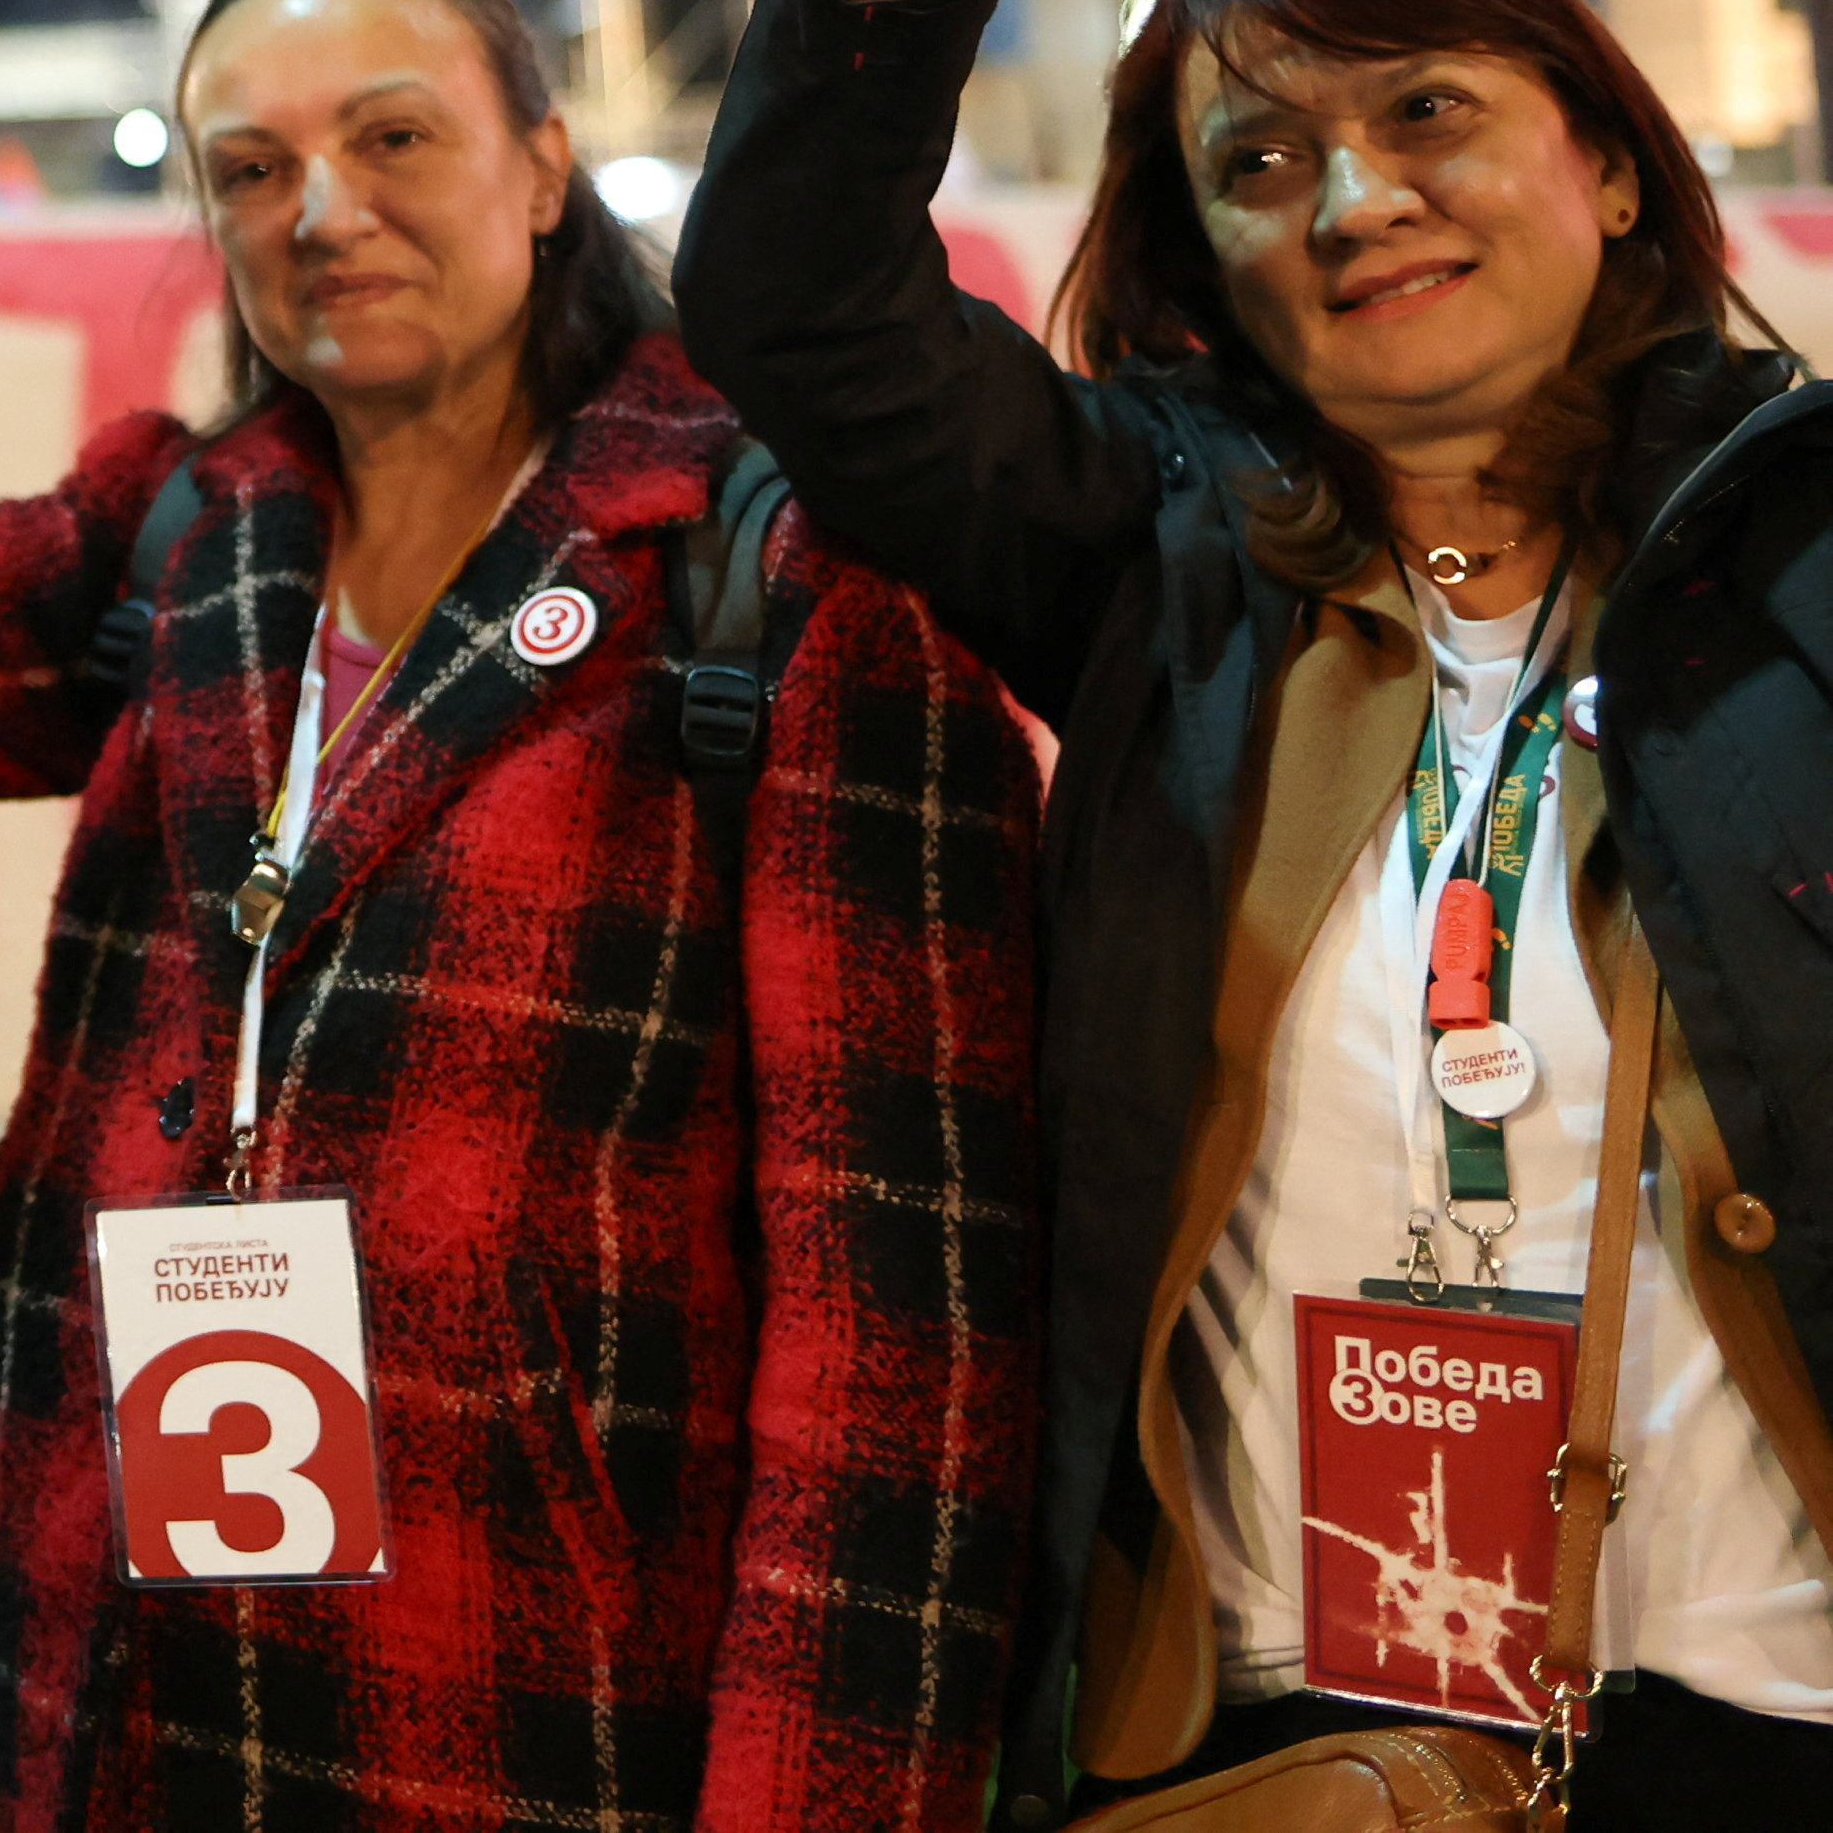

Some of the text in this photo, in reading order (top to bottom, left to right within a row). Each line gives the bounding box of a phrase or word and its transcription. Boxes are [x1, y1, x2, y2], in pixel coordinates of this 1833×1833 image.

[533, 606, 568, 640] 3
[1442, 1047, 1518, 1073] СТУДЕНТИ
[1441, 1062, 1526, 1088] ПОБЕЂУЈУ!
[154, 1253, 290, 1278] СТУДЕНТИ
[155, 1278, 289, 1303] ПОБЕЂУЈУ
[1334, 1335, 1544, 1402] Победа
[159, 1360, 336, 1576] 3
